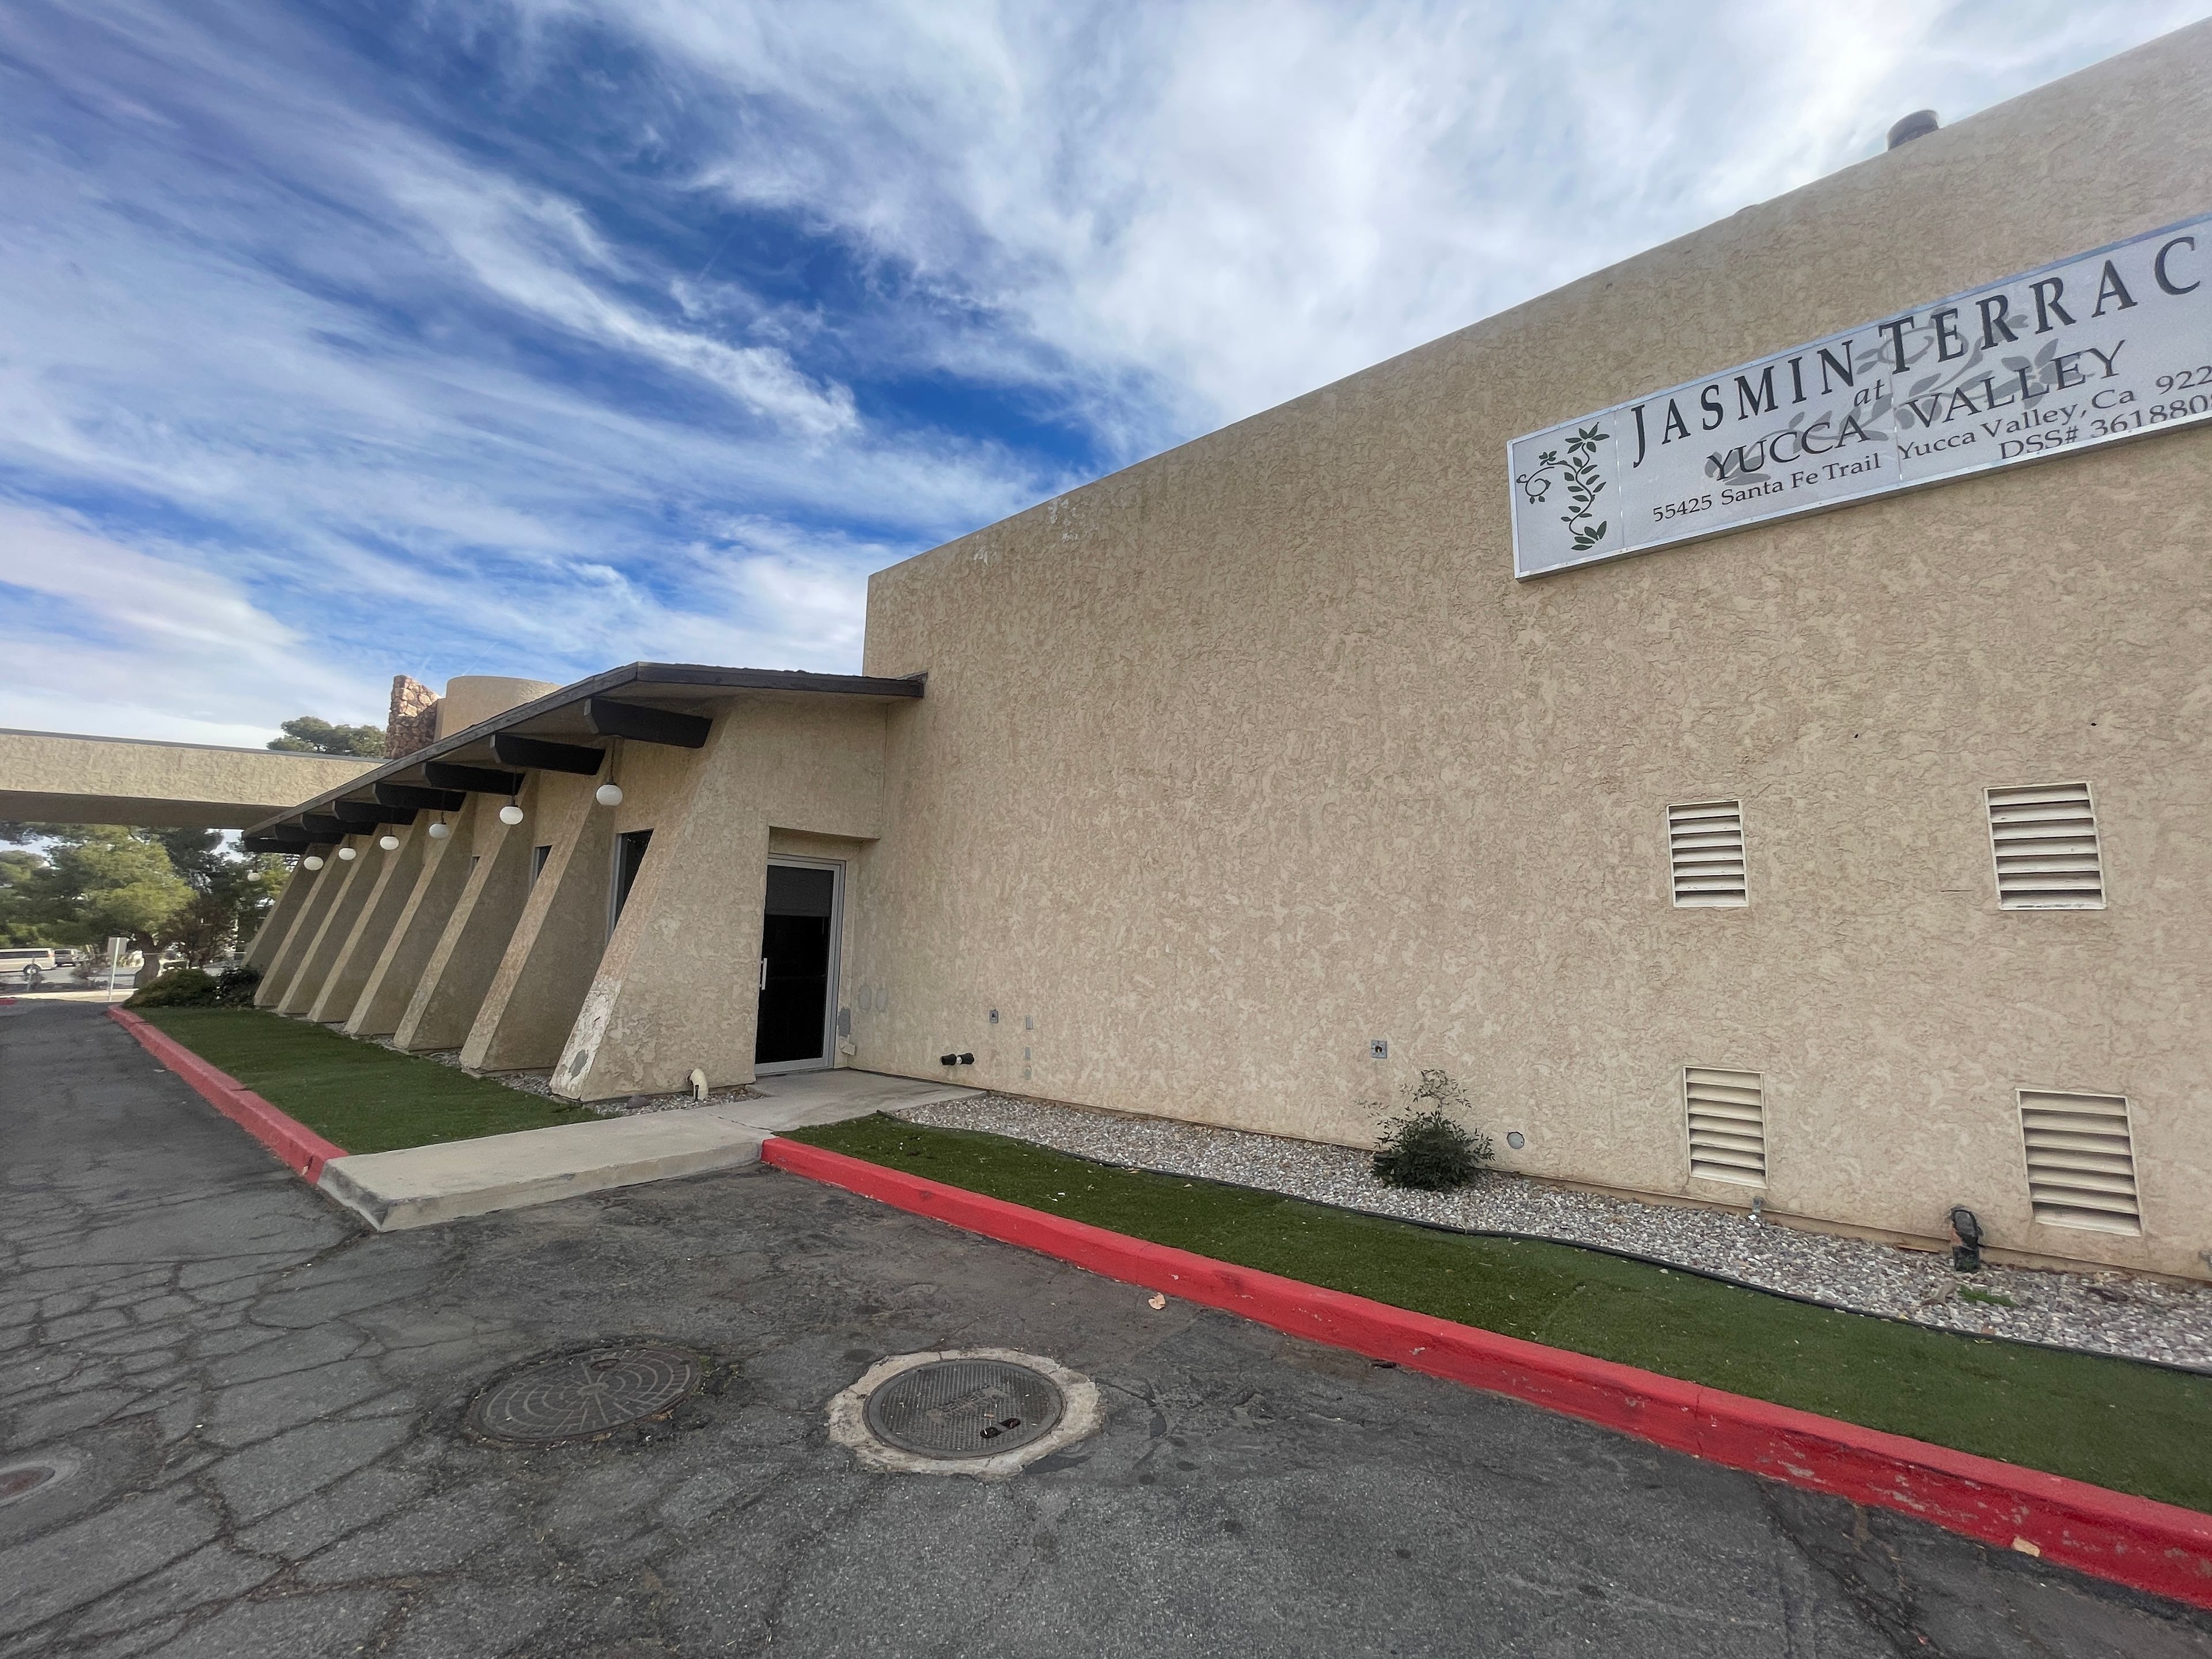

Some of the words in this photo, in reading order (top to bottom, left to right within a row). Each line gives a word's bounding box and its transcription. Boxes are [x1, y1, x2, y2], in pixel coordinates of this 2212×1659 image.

[1631, 339, 1854, 468] JASMIN
[1878, 236, 2201, 375] TERRAC
[1706, 415, 1870, 482] YUCCA
[1902, 339, 2126, 428] VALLEY
[1854, 378, 1885, 407] at
[1653, 494, 1713, 522] 55425
[1721, 482, 1783, 506] Santa
[1790, 471, 1819, 488] Fe
[1822, 453, 1881, 480] Trail
[1897, 431, 1976, 460] Yucca
[1980, 404, 2086, 438] Valley,
[2091, 389, 2137, 409] Ca
[2000, 426, 2078, 459] DSS#
[2090, 393, 2212, 438] 361880
